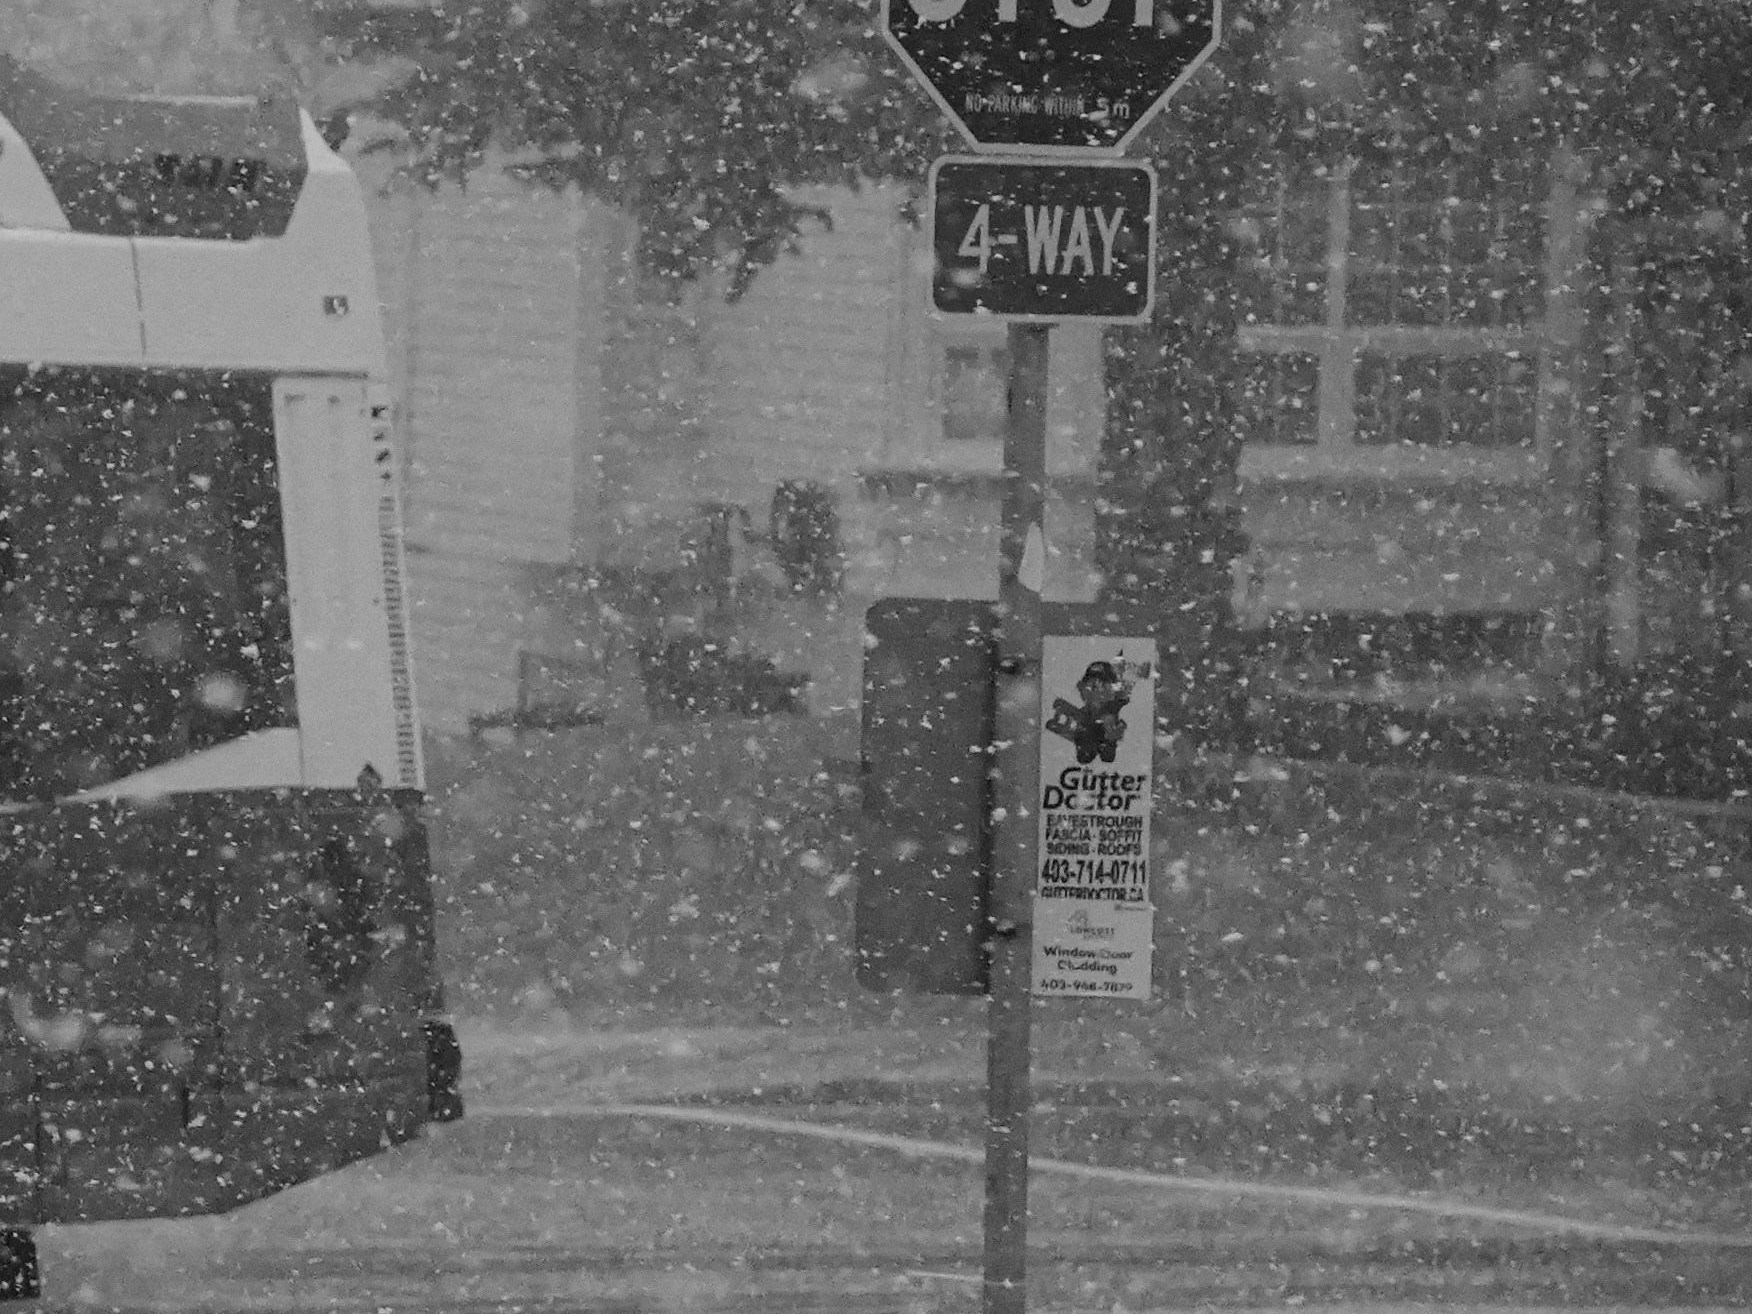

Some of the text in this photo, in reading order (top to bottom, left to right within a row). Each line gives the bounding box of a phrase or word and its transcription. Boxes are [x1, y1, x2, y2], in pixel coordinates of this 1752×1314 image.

[988, 94, 1038, 114] PARKING
[958, 203, 1126, 276] 4-WAY
[1060, 766, 1146, 791] Gutter
[1042, 858, 1146, 884] 403-714-0711
